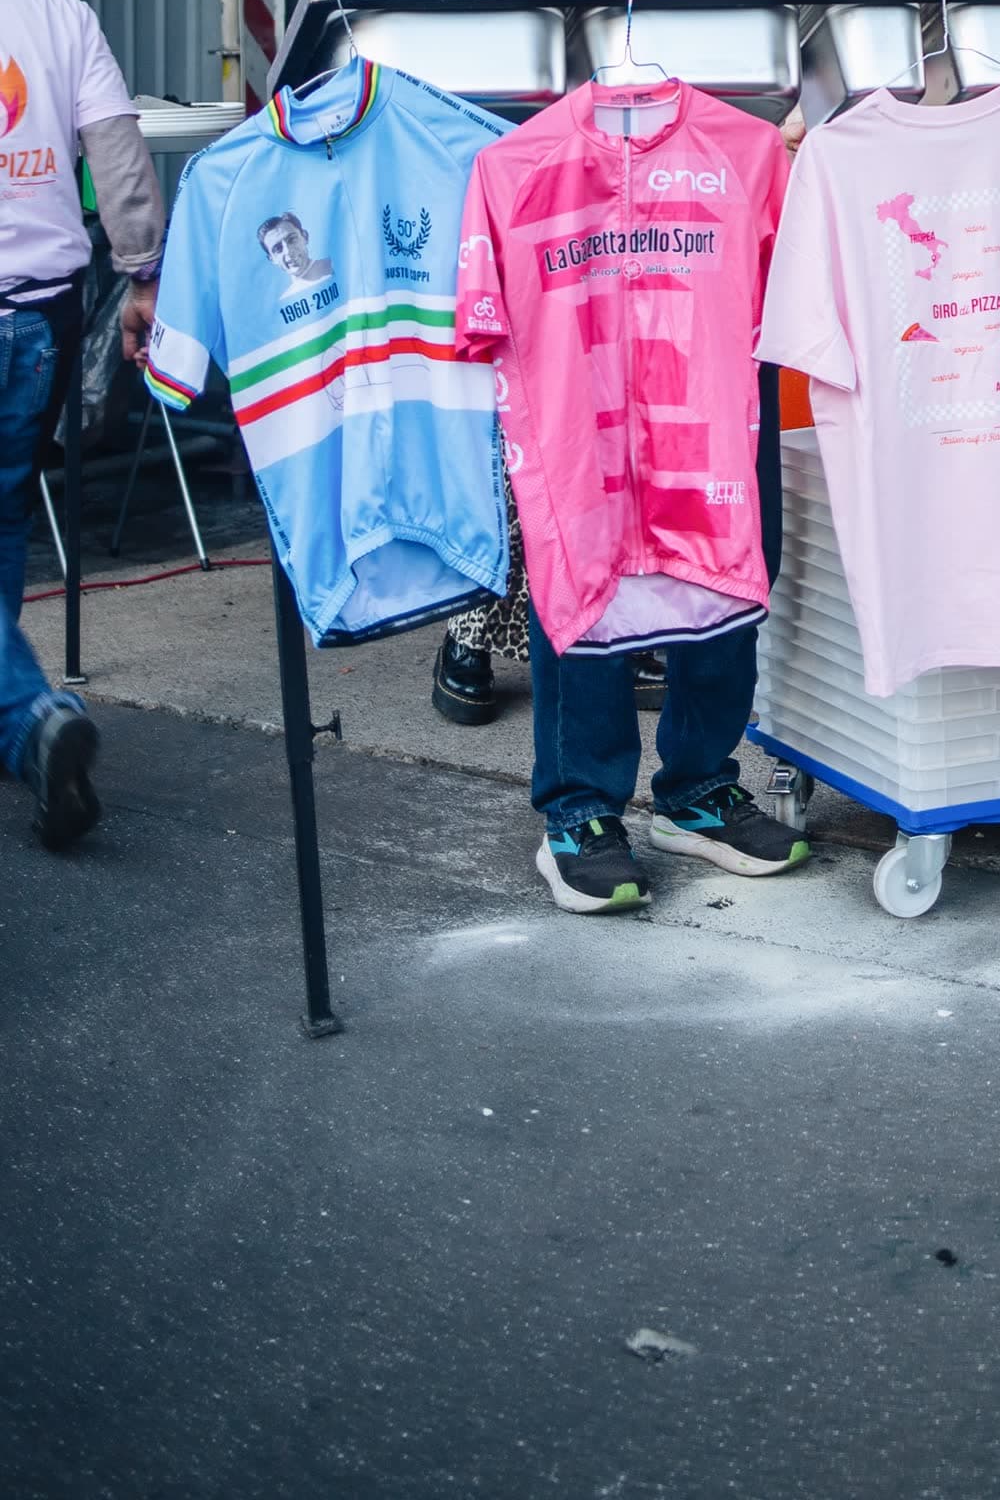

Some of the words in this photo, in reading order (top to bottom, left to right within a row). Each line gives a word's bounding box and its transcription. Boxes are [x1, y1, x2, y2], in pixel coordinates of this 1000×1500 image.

[0, 147, 57, 178] PIZZA
[648, 168, 726, 195] enel
[544, 248, 568, 273] La
[630, 228, 669, 254] dello
[673, 228, 715, 258] Sport
[280, 282, 340, 324] 1960-2010
[932, 302, 958, 319] GIRO
